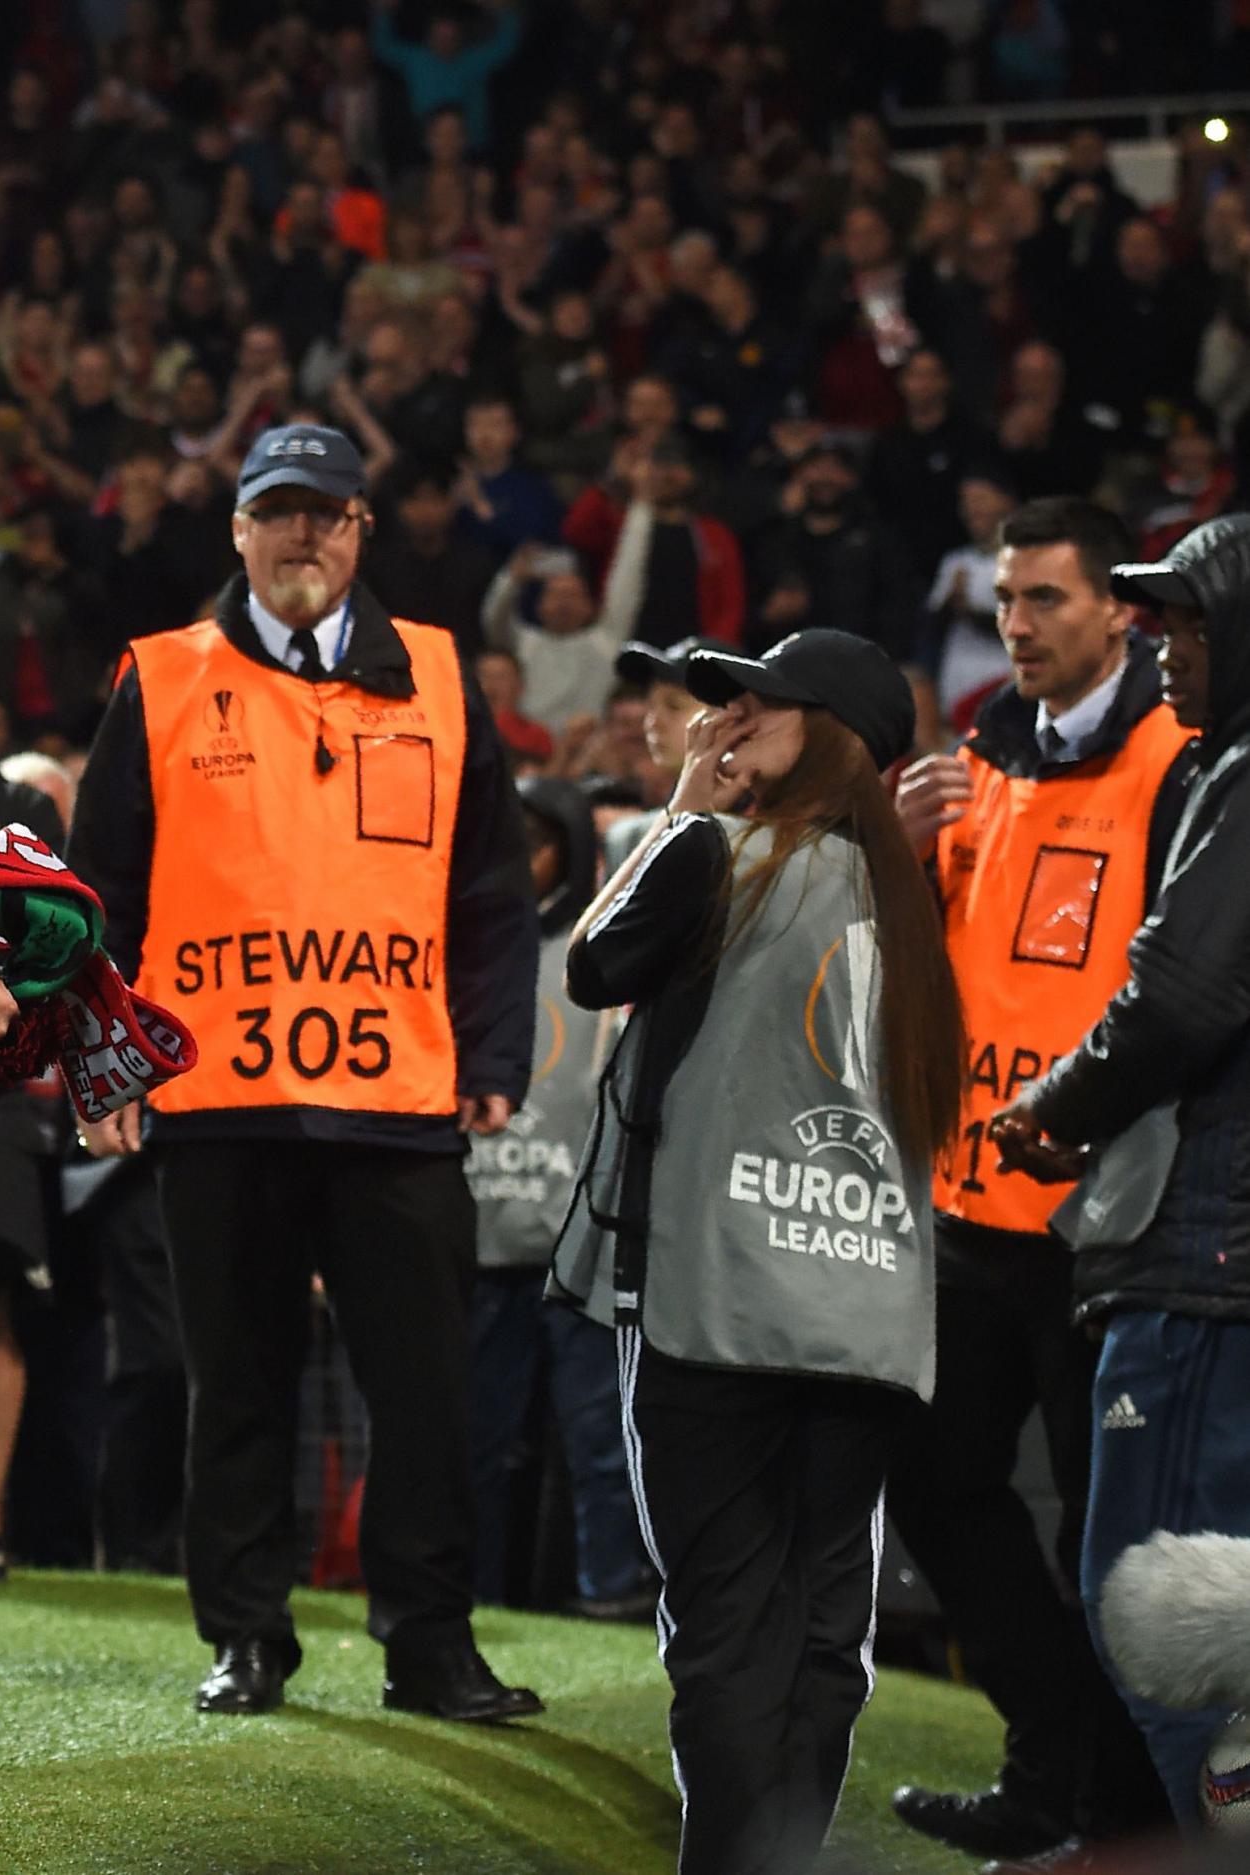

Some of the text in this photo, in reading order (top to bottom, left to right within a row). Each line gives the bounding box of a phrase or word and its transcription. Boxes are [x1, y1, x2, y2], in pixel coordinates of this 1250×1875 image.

[191, 752, 256, 770] EUROPA
[231, 1007, 391, 1080] 305
[796, 1112, 887, 1166] UEFA
[768, 1216, 897, 1272] LEAGUE
